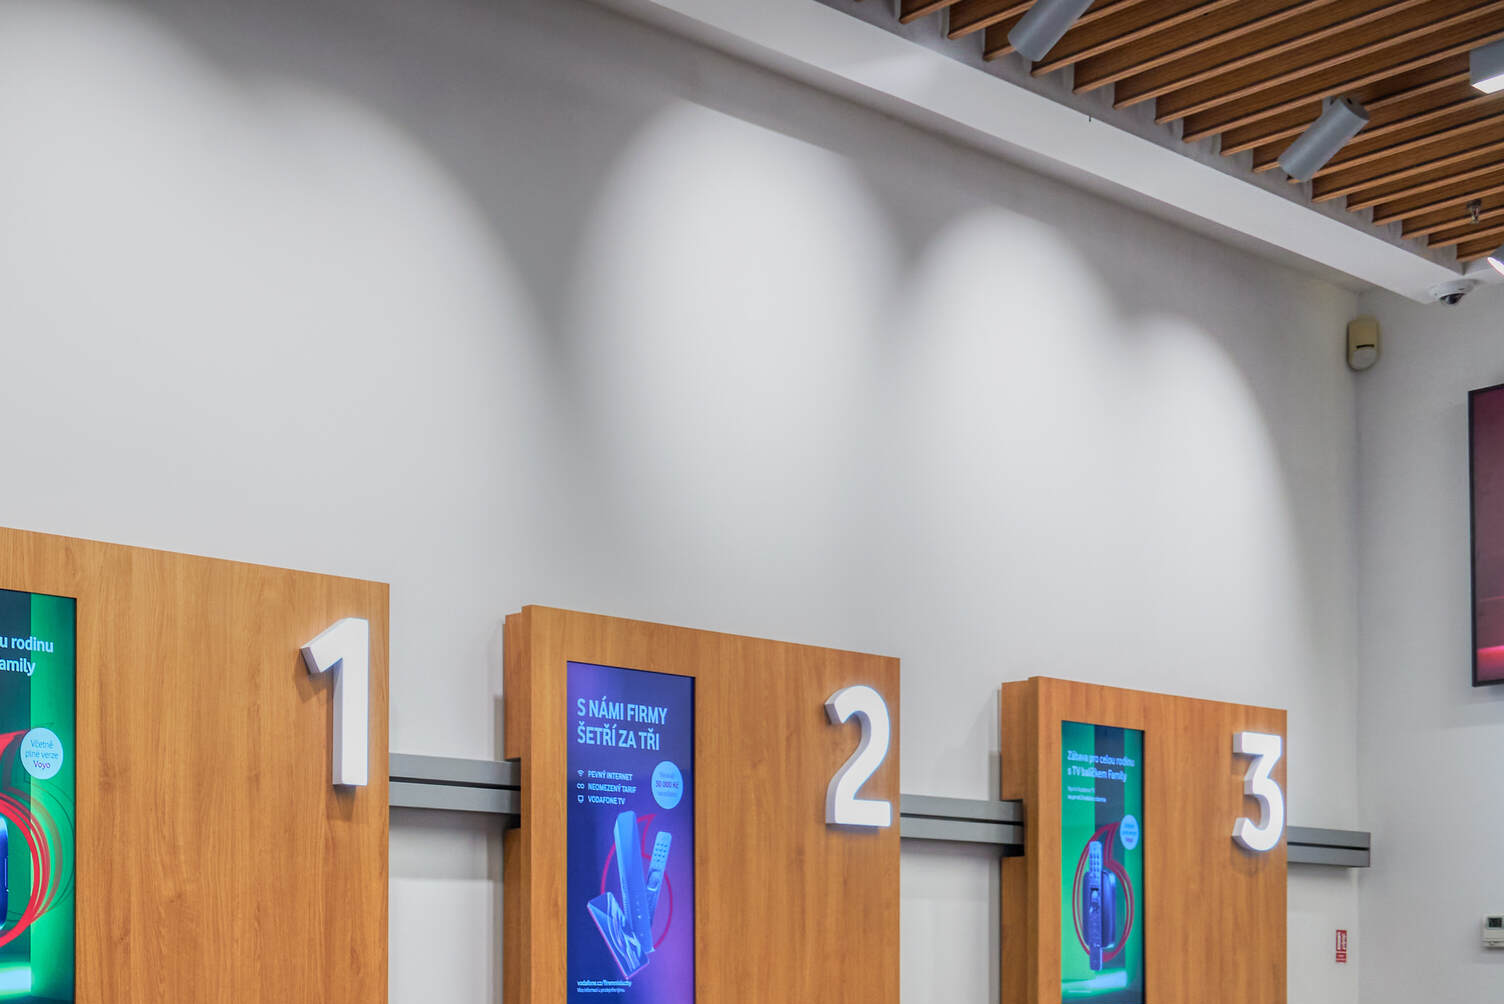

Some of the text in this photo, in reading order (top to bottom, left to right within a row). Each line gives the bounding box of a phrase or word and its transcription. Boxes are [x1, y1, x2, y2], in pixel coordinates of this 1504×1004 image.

[11, 636, 54, 653] rodinu
[299, 617, 369, 786] 1
[577, 696, 667, 725] S NÁMI FIRMY
[577, 720, 660, 750] ŠETŘÍ ZA TŘI
[33, 760, 51, 770] Voyo
[824, 685, 892, 827] 2
[588, 770, 633, 781] PEVNÝ INTERNET
[588, 783, 621, 792] NEOMEZENÝ
[1231, 731, 1285, 852] 3
[588, 795, 617, 804] VODAFONE
